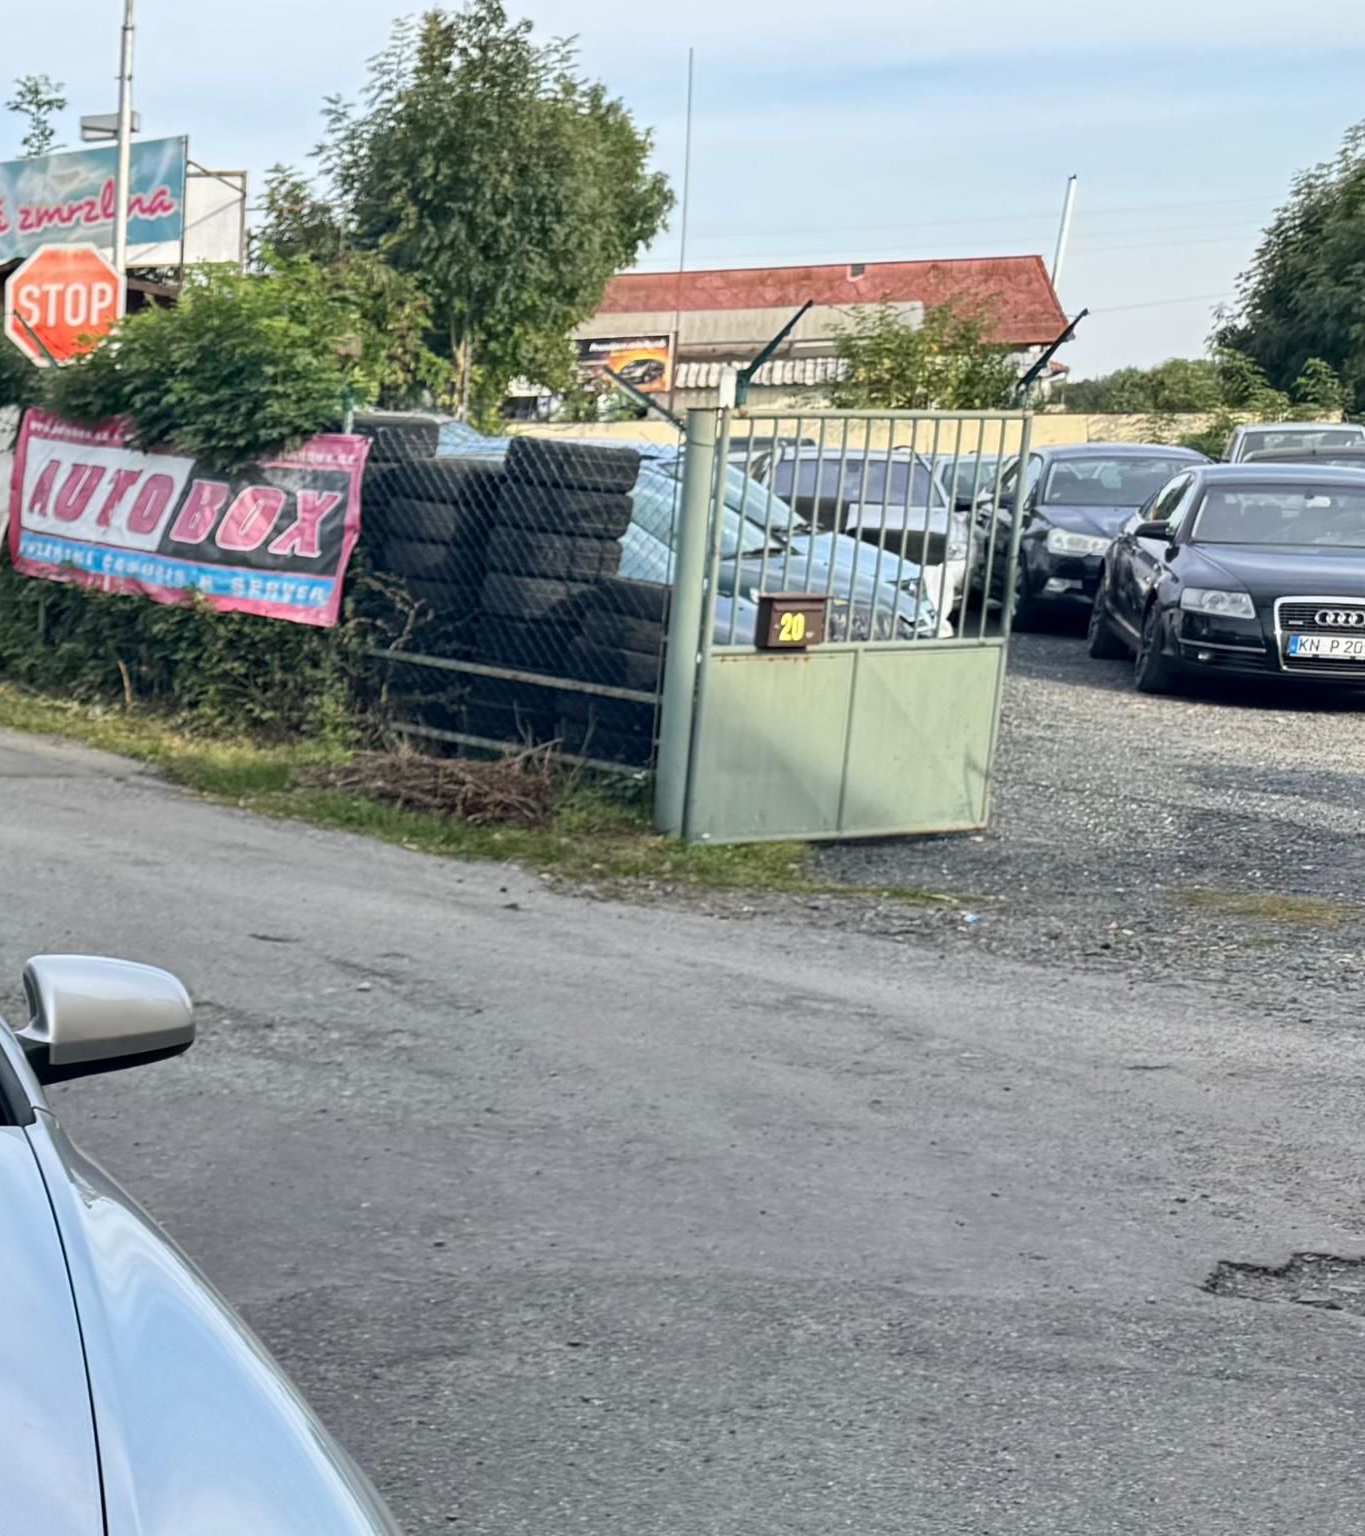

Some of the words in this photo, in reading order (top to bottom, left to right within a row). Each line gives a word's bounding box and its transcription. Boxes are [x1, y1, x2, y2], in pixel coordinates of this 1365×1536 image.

[18, 178, 175, 231] zmrzlna
[18, 282, 113, 328] STOP
[778, 612, 806, 641] 20
[1298, 637, 1321, 652] KN
[1329, 639, 1340, 653] P
